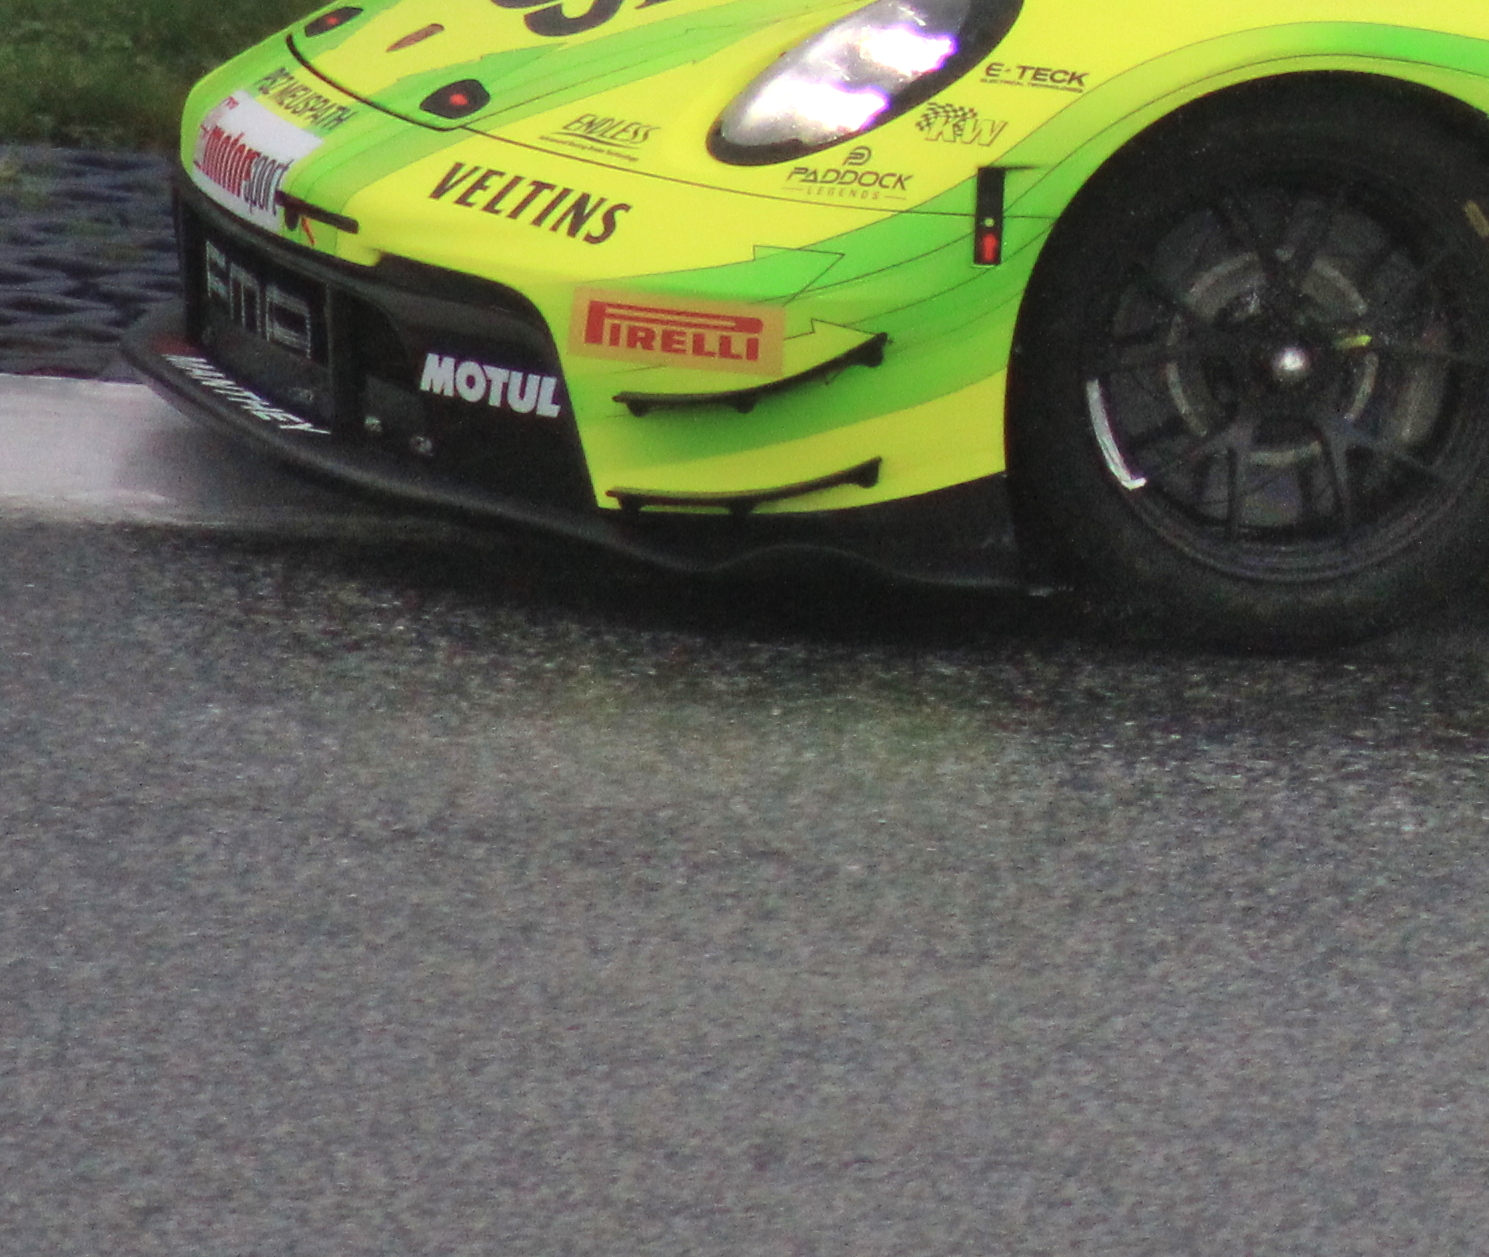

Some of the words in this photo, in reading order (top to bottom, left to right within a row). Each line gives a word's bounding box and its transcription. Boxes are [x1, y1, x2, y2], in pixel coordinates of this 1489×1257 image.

[561, 112, 662, 144] ENDLESS
[920, 108, 1008, 148] KW
[785, 166, 915, 192] PADDOCK
[806, 186, 880, 200] LEGENDS
[427, 162, 634, 245] VELTINS
[585, 299, 764, 362] PIRELLI
[419, 353, 562, 419] MOTUL
